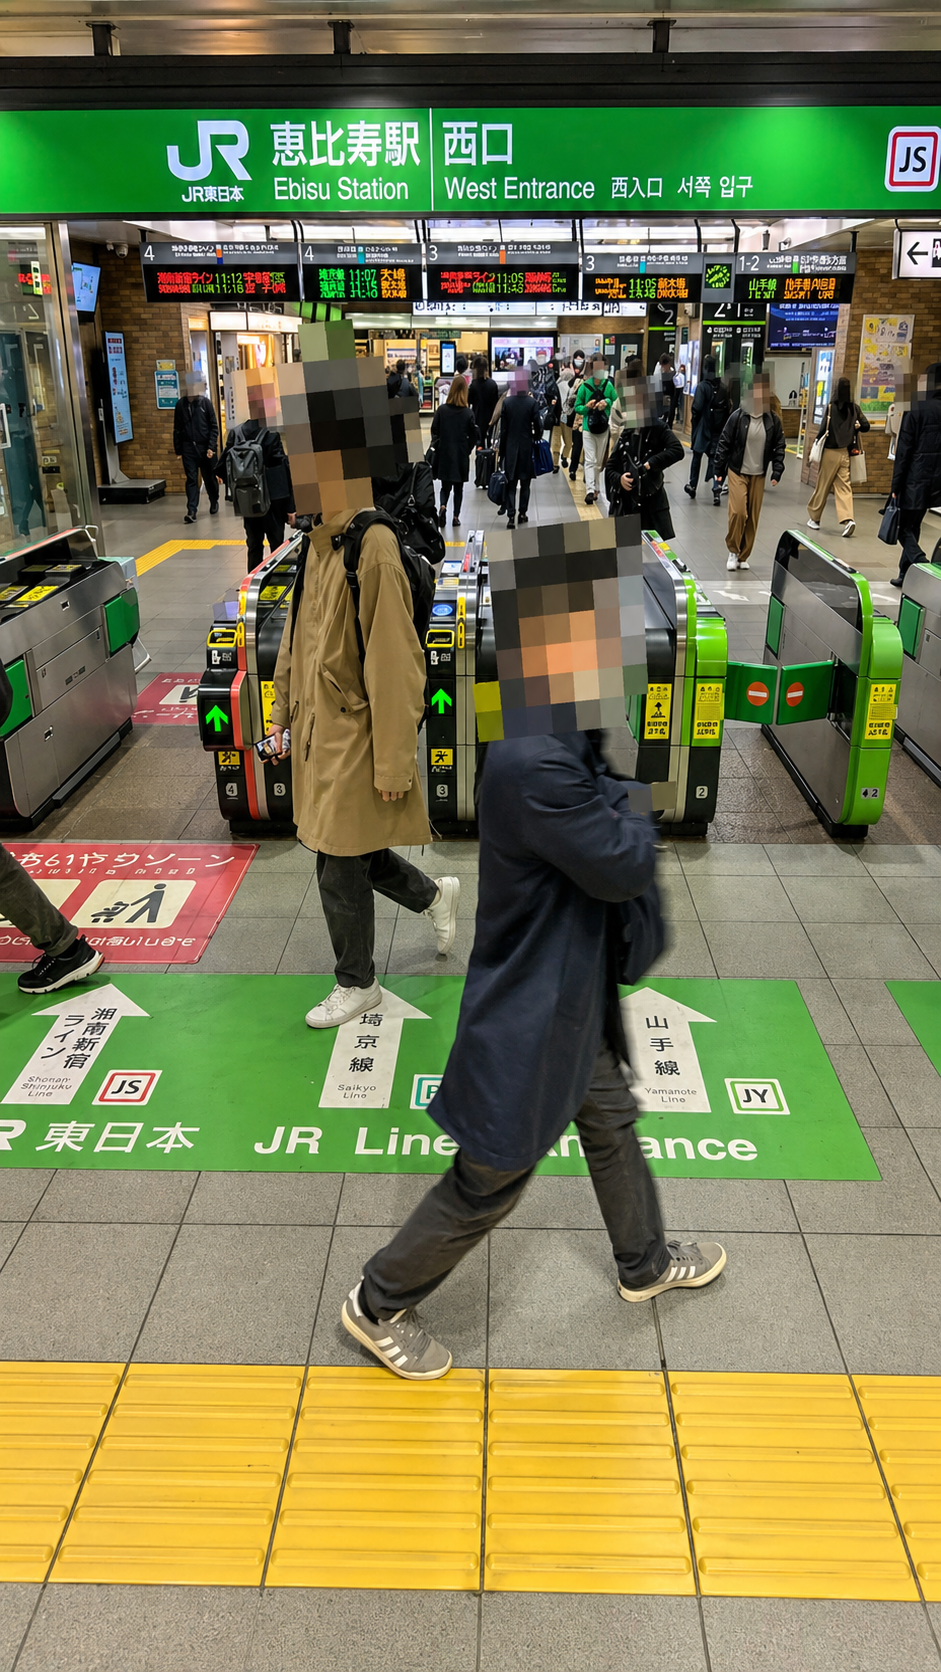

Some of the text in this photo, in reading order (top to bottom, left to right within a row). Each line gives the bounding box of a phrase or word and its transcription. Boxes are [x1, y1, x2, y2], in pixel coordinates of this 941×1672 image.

[167, 120, 252, 181] JR
[270, 120, 421, 167] 恵比寿駅
[442, 121, 513, 166] 西口
[898, 145, 927, 173] JS
[182, 186, 244, 202] JR東日本
[274, 177, 408, 200] Ebisu Station
[445, 177, 595, 200] West Entrance
[611, 177, 663, 199] 西入口
[677, 175, 753, 198] 서쪽 입구
[144, 245, 155, 261] 4
[304, 245, 314, 261] 4
[429, 245, 438, 261] 3
[586, 255, 595, 271] 3
[739, 255, 760, 271] 1-2
[349, 268, 377, 281] 11:07
[228, 785, 234, 794] 4
[276, 785, 283, 794] 3
[439, 786, 445, 795] 3
[698, 787, 705, 796] 2
[41, 1015, 84, 1059] ライン
[645, 1015, 680, 1076] 山手線
[111, 1080, 142, 1094] JS
[337, 1084, 377, 1092] Saikyo
[644, 1087, 697, 1096] Yamanote
[742, 1089, 768, 1103] JY
[253, 1126, 323, 1154] JR
[354, 1127, 461, 1156] Line
